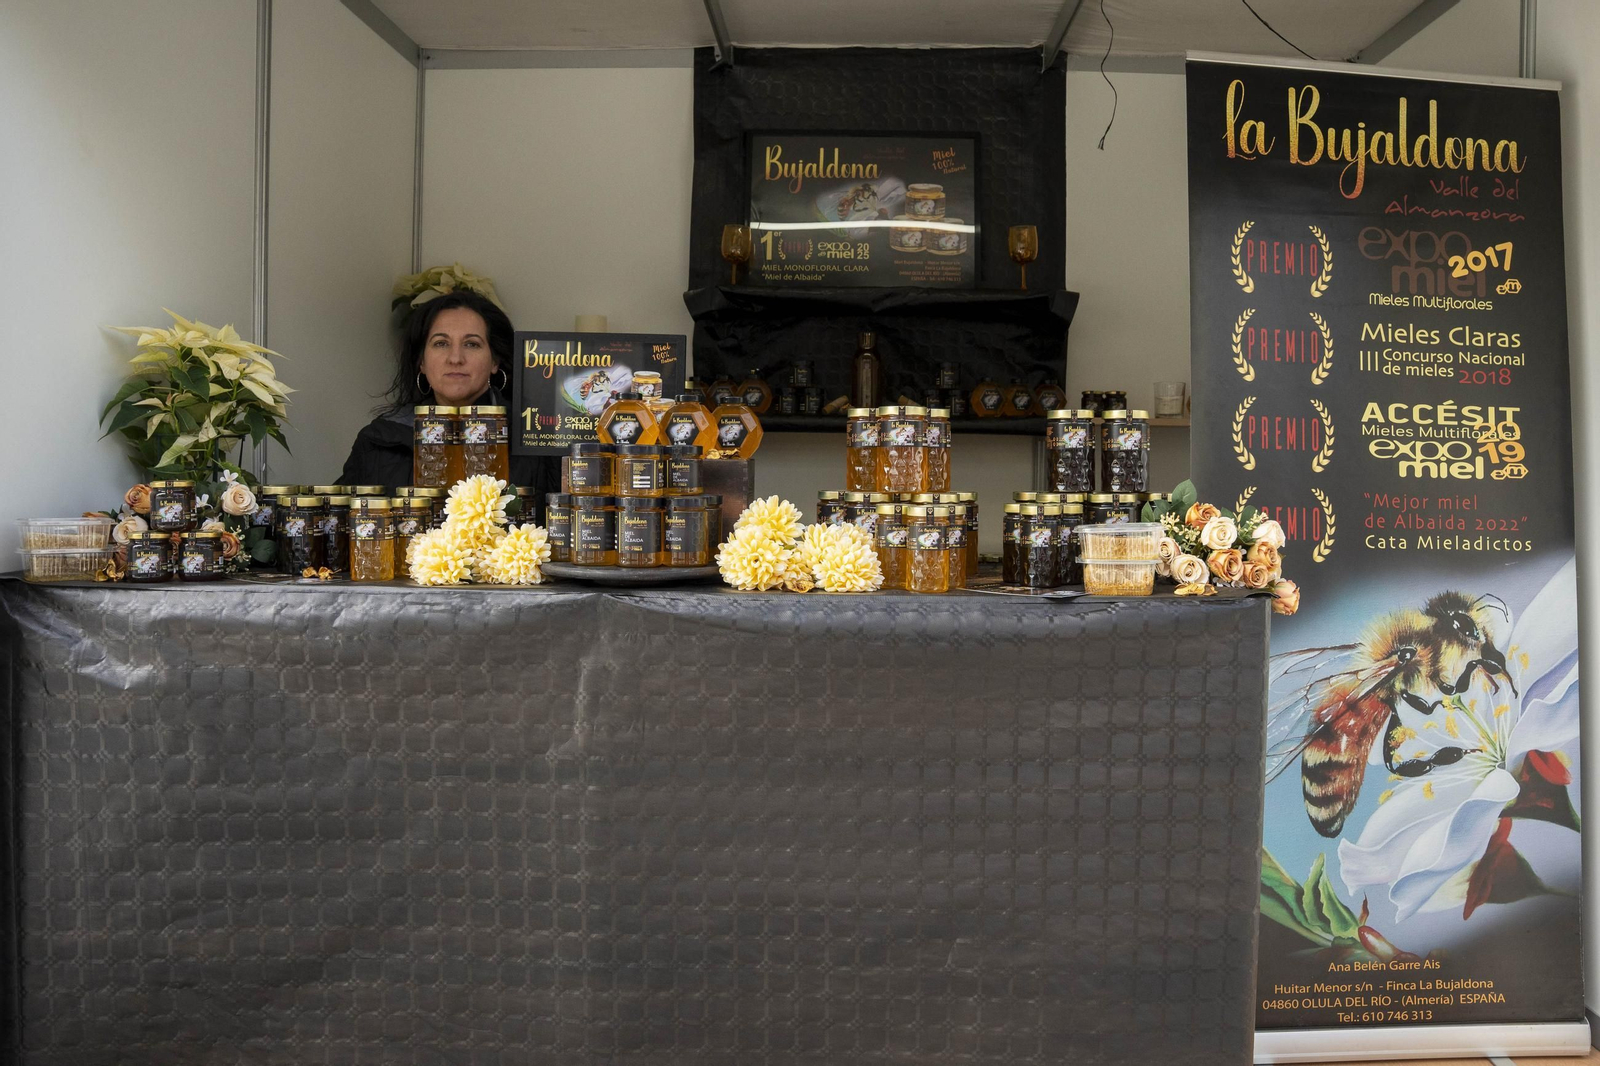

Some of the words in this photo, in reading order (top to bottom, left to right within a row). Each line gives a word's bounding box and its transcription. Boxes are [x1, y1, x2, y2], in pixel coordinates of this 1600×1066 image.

[1287, 84, 1528, 200] Bujaldona
[932, 147, 956, 160] Miel
[764, 144, 882, 194] Bujaldona
[932, 159, 955, 171] 100%
[1430, 176, 1479, 198] Valle
[1493, 178, 1519, 200] del
[1385, 196, 1526, 221] Almanzora
[817, 241, 851, 251] expo
[826, 248, 855, 259] miel
[857, 243, 870, 251] 20
[857, 251, 870, 260] 25
[1357, 226, 1472, 265] expo
[1246, 239, 1318, 277] PREMIO
[1447, 241, 1514, 279] 2017
[1391, 257, 1487, 298] miel
[1368, 292, 1410, 308] Mieles
[1412, 294, 1494, 312] Multiflorales
[1247, 327, 1319, 364] PREMIO
[1360, 322, 1441, 345] Mieles
[1448, 325, 1521, 348] Claras
[652, 342, 671, 353] Miel
[652, 351, 670, 361] 100%
[524, 339, 616, 379] Bujaldona
[1359, 350, 1379, 372] III
[1382, 348, 1454, 363] Concurso
[1458, 351, 1525, 366] Nacional
[1382, 361, 1401, 376] de
[1405, 363, 1454, 378] mieles
[1458, 367, 1512, 386] 2018
[564, 416, 590, 424] expo
[1360, 399, 1521, 427] ACCÉSIT
[571, 422, 593, 431] miel
[1248, 415, 1320, 452] PREMIO
[1361, 424, 1414, 438] Mieles
[1418, 425, 1521, 440] Multifloraes
[1473, 421, 1521, 443] 20
[1368, 438, 1473, 463] expo
[1478, 441, 1526, 464] 19
[1398, 455, 1485, 480] miel
[1363, 492, 1429, 513] "Mejor
[1437, 494, 1478, 510] miel
[1364, 512, 1386, 529] de
[1394, 513, 1466, 531] Albaida
[1475, 516, 1528, 531] 2022"
[1365, 534, 1408, 550] Cata
[1416, 535, 1533, 551] Mieladictos
[1328, 961, 1351, 972] Ana
[1353, 960, 1387, 972] Belén
[1389, 960, 1421, 971] Garre
[1423, 959, 1441, 971] Ais
[1274, 983, 1310, 994] Huitar
[1313, 982, 1352, 994] Menor
[1355, 981, 1373, 993] s/n
[1386, 980, 1417, 991] Finca
[1419, 980, 1433, 990] La
[1435, 979, 1494, 992] Bujaldona
[1262, 999, 1299, 1010] 04860
[1301, 998, 1342, 1009] OLULA
[1345, 996, 1368, 1007] DEL
[1371, 995, 1391, 1007] RÍO
[1401, 993, 1454, 1008] (Almería)
[1460, 991, 1506, 1004] ESPAÑA
[1337, 1012, 1360, 1023] Tel.:
[1362, 1011, 1384, 1022] 610
[1387, 1010, 1409, 1021] 746
[1411, 1010, 1433, 1021] 313
